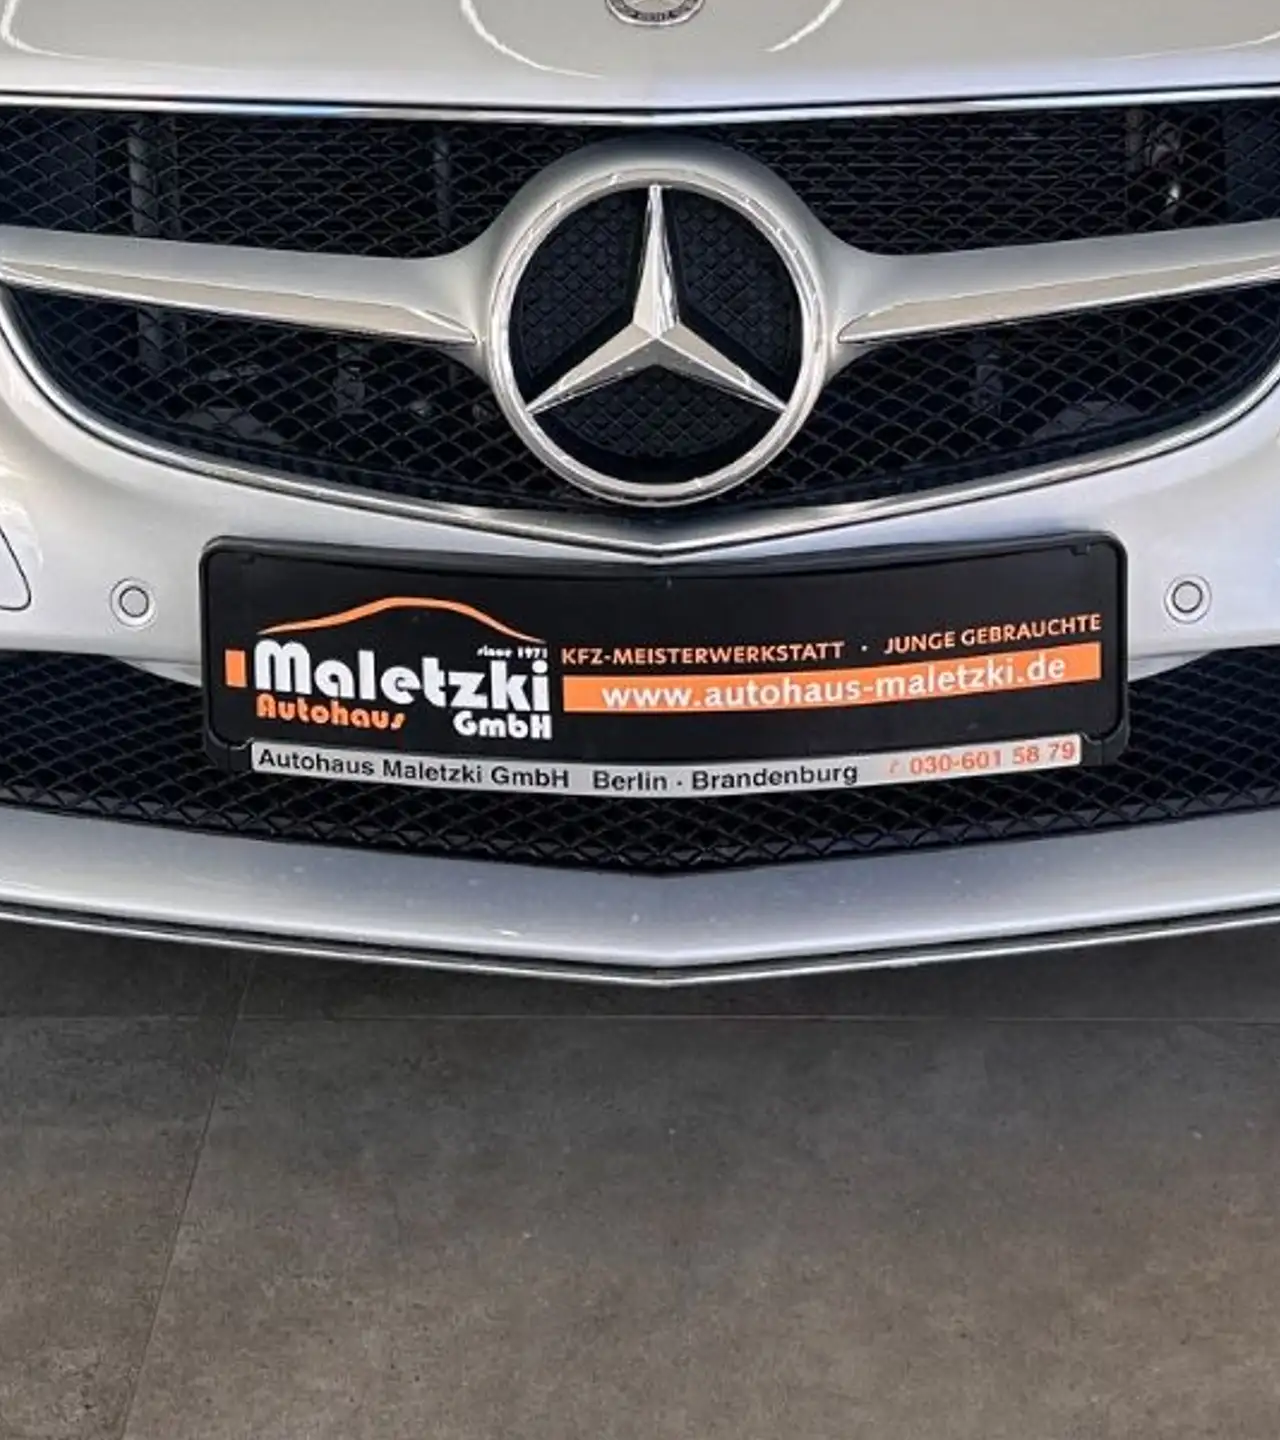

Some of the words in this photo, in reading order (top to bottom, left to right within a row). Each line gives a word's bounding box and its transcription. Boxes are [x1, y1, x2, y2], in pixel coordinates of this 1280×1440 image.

[517, 645, 549, 659] 1971
[561, 641, 845, 666] KFZ-MEISTERWERKSTATT
[884, 631, 956, 655] JUNGE
[961, 613, 1102, 646] GEBRAUCHTE
[254, 639, 550, 712] Maletzki
[601, 652, 1066, 708] www.autohaus-maletzki.de
[256, 693, 406, 731] Autohaus
[453, 711, 553, 740] GmbH
[258, 748, 375, 777] Autohaus
[382, 760, 482, 784] Maletzki
[491, 767, 569, 789] GmbH
[593, 770, 668, 791] Berlin
[692, 765, 858, 790] Brandenburg
[910, 750, 1002, 775] 030-601
[1012, 746, 1040, 765] 58
[1048, 742, 1076, 760] 79
